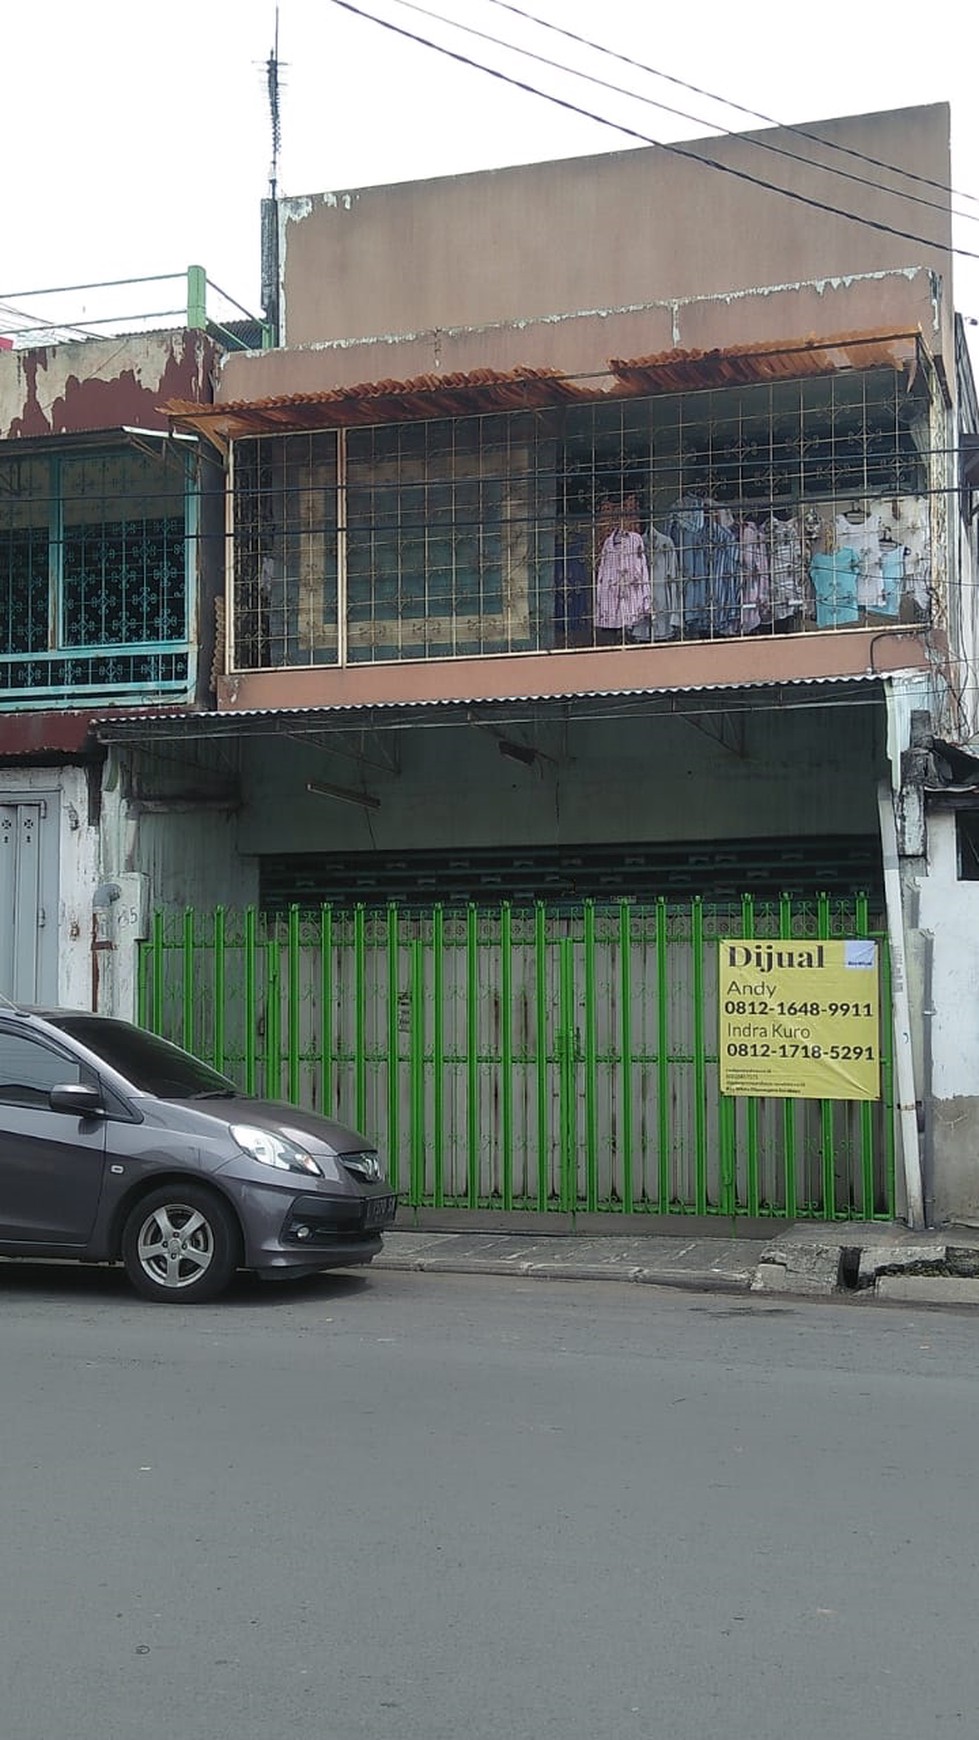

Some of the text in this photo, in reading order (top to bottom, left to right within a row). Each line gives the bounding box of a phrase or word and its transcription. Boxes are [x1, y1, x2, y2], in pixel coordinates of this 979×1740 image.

[728, 944, 825, 973] Dijual
[727, 981, 777, 999] Andy
[724, 1001, 874, 1017] 0812-1648-9911
[727, 1023, 811, 1039] Indra Kuro
[727, 1043, 875, 1061] 0812-1718-5291
